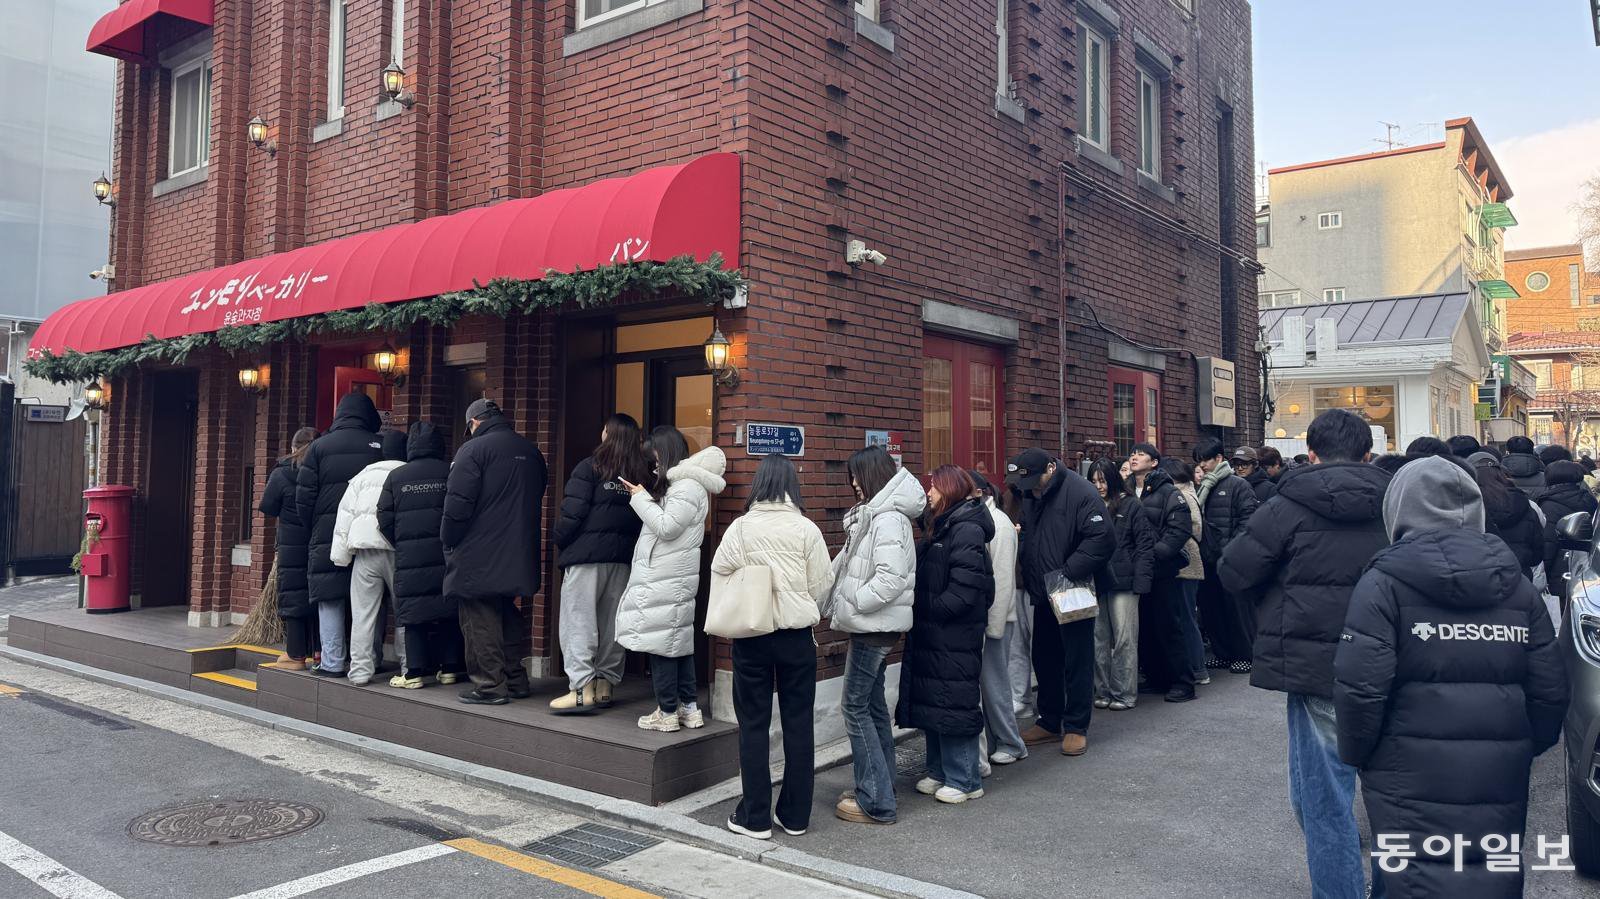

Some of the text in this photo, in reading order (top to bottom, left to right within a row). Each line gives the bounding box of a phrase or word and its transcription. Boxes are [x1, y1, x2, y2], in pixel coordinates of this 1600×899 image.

[610, 237, 650, 262] パン
[223, 306, 263, 325] 윤숲과자점
[1438, 623, 1529, 643] DESCENTE
